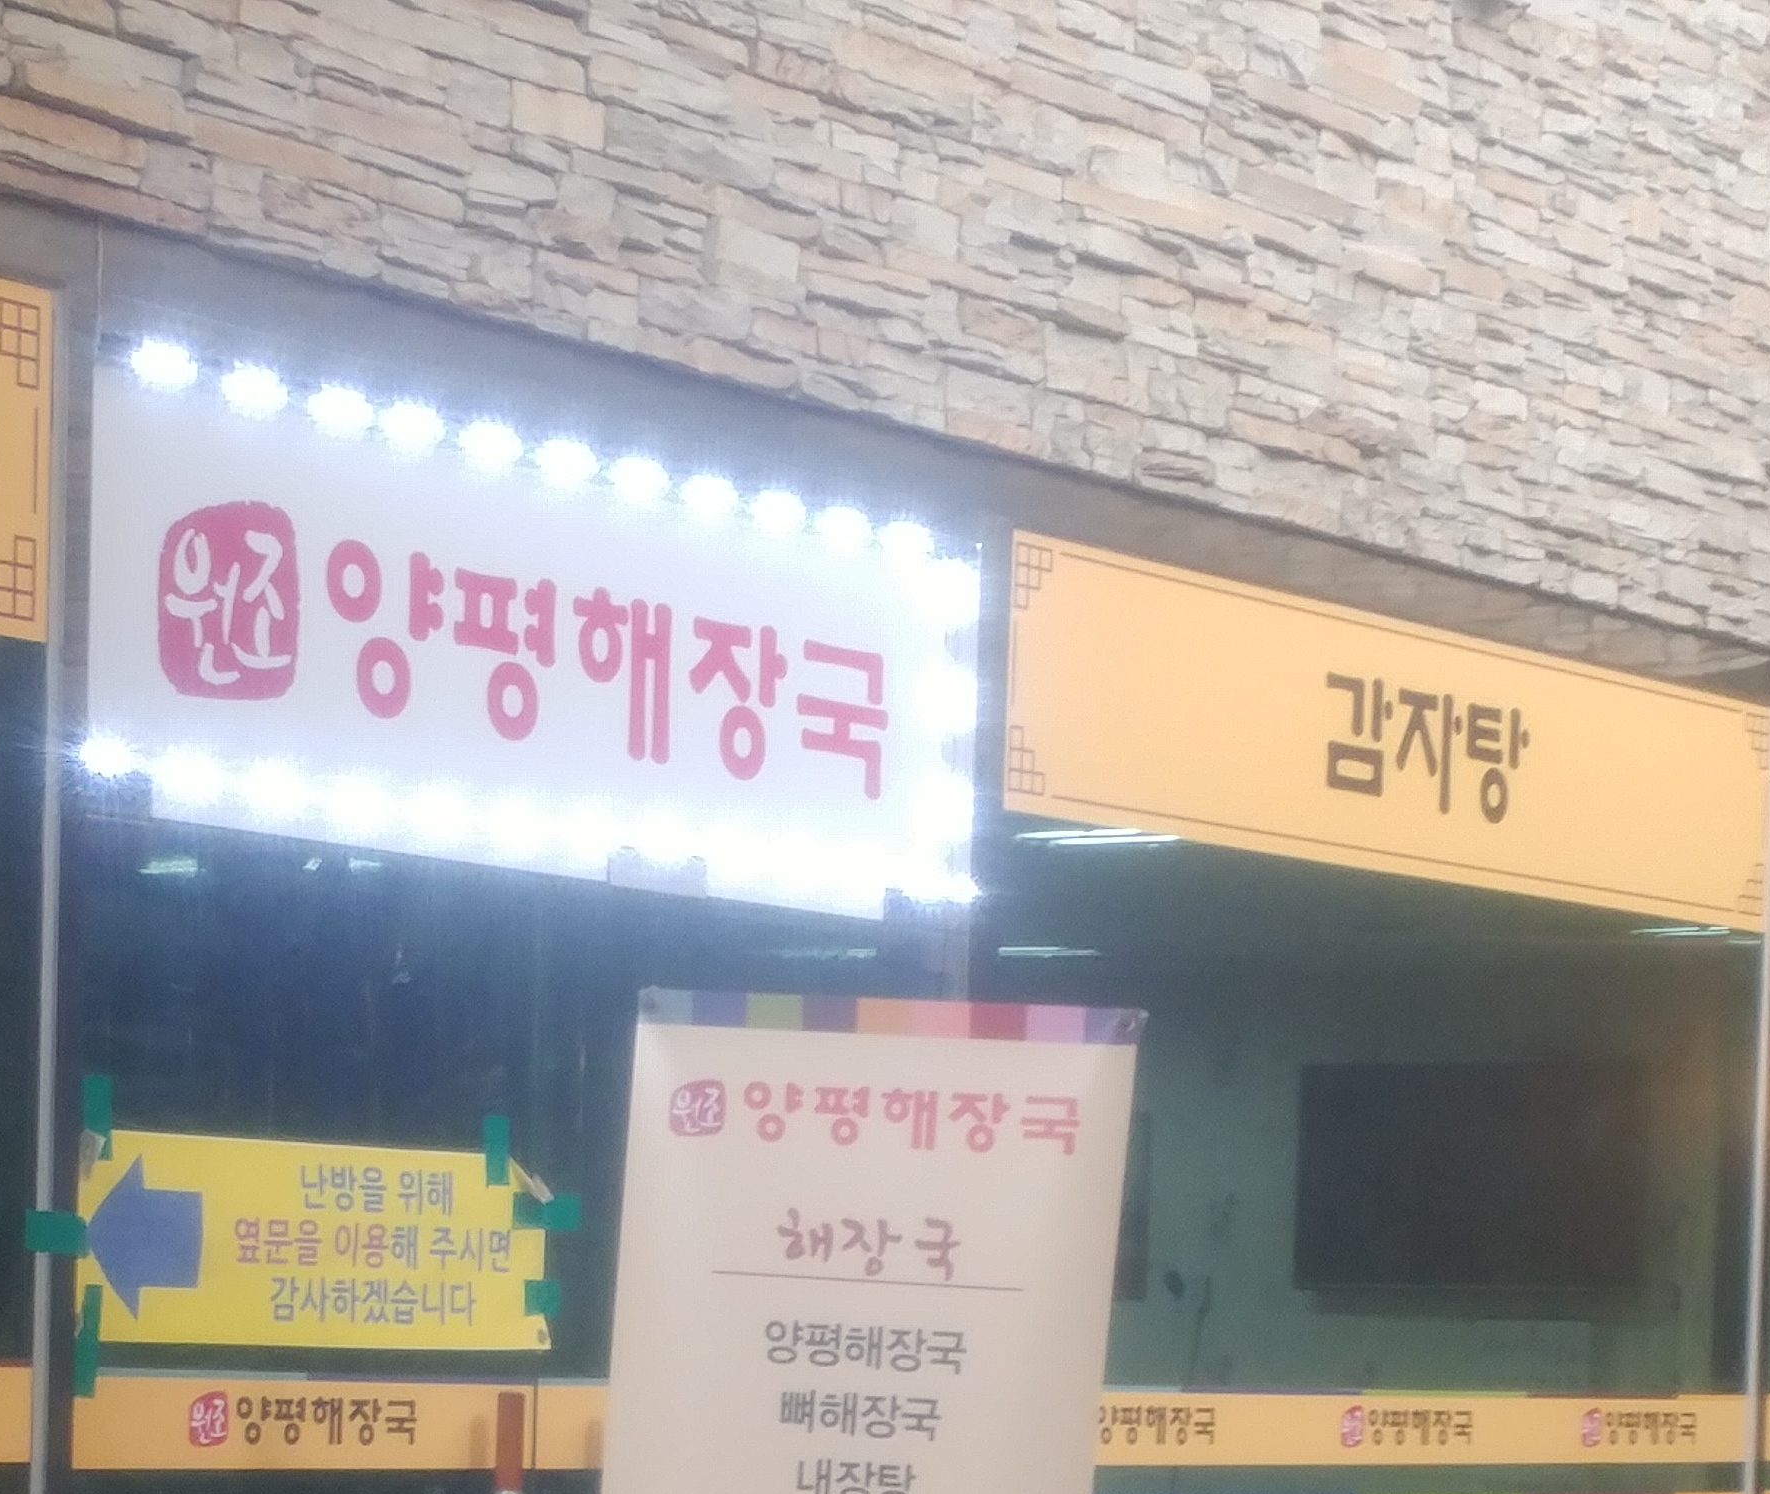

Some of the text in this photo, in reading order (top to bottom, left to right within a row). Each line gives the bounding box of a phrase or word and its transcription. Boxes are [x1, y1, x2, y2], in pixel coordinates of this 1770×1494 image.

[163, 525, 890, 801] 원조 양평해장국
[1324, 671, 1531, 825] 감자탕
[742, 1080, 1082, 1156] 양평해장국
[300, 1163, 455, 1215] 난방을 위해
[234, 1216, 512, 1274] 옆문을 이용해 주시면
[777, 1207, 962, 1281] 해장국
[270, 1276, 478, 1327] 감사하겠습니다
[764, 1319, 968, 1375] 양평해장국
[235, 1394, 419, 1446] 양평해장국
[778, 1388, 942, 1442] 뼈해장국
